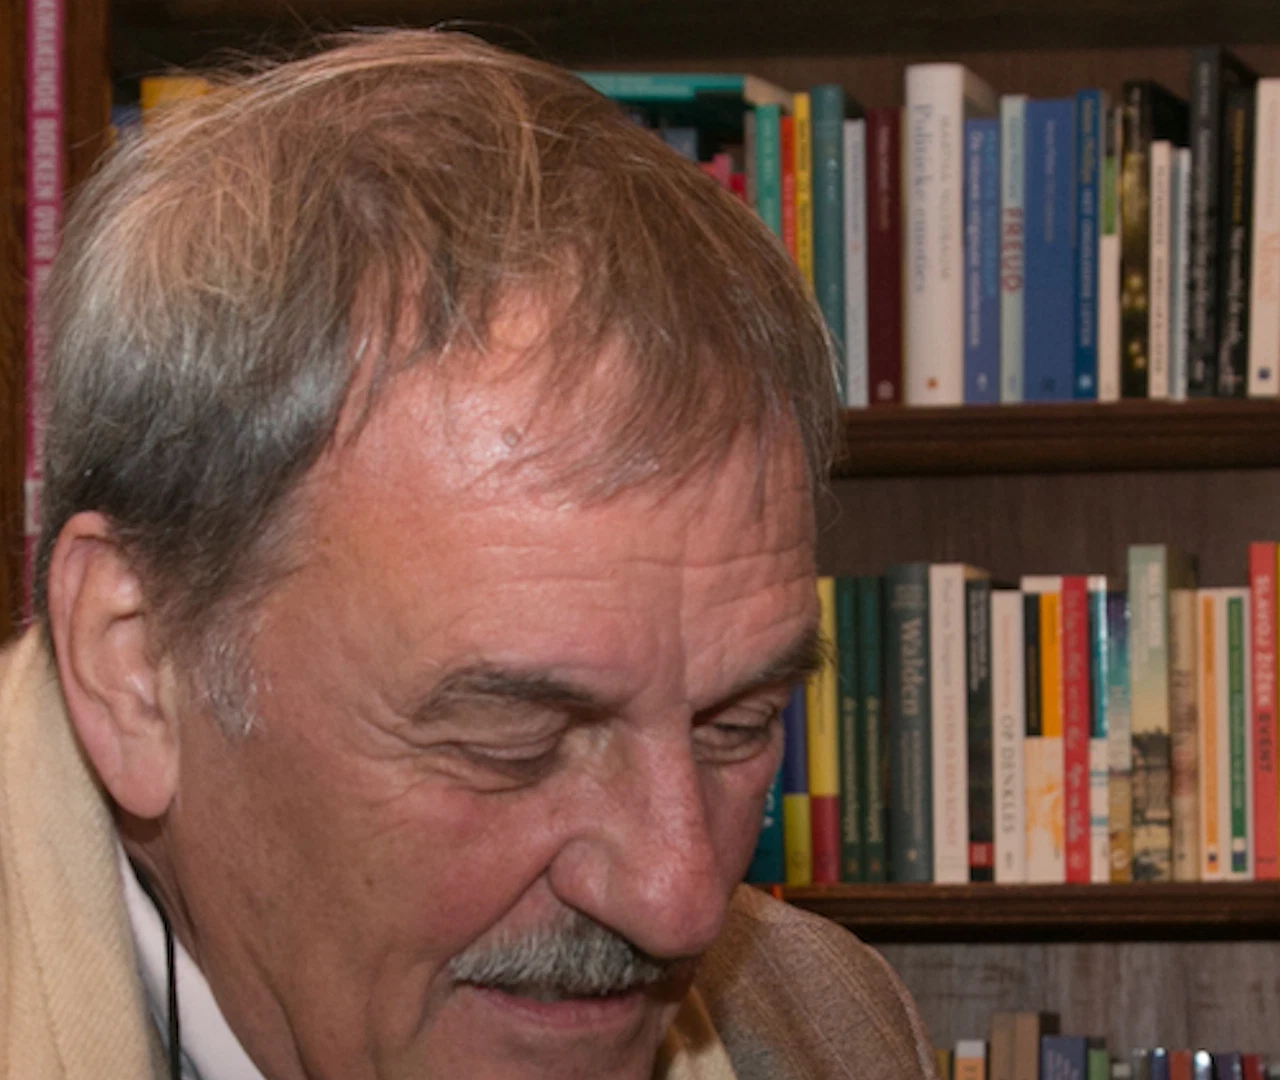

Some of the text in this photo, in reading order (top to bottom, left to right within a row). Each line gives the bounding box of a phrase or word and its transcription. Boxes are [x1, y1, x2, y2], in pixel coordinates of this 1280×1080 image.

[1002, 206, 1024, 294] FREUD
[1255, 573, 1272, 648] SLAVOJ
[900, 615, 926, 718] Walden
[999, 714, 1017, 741] OP
